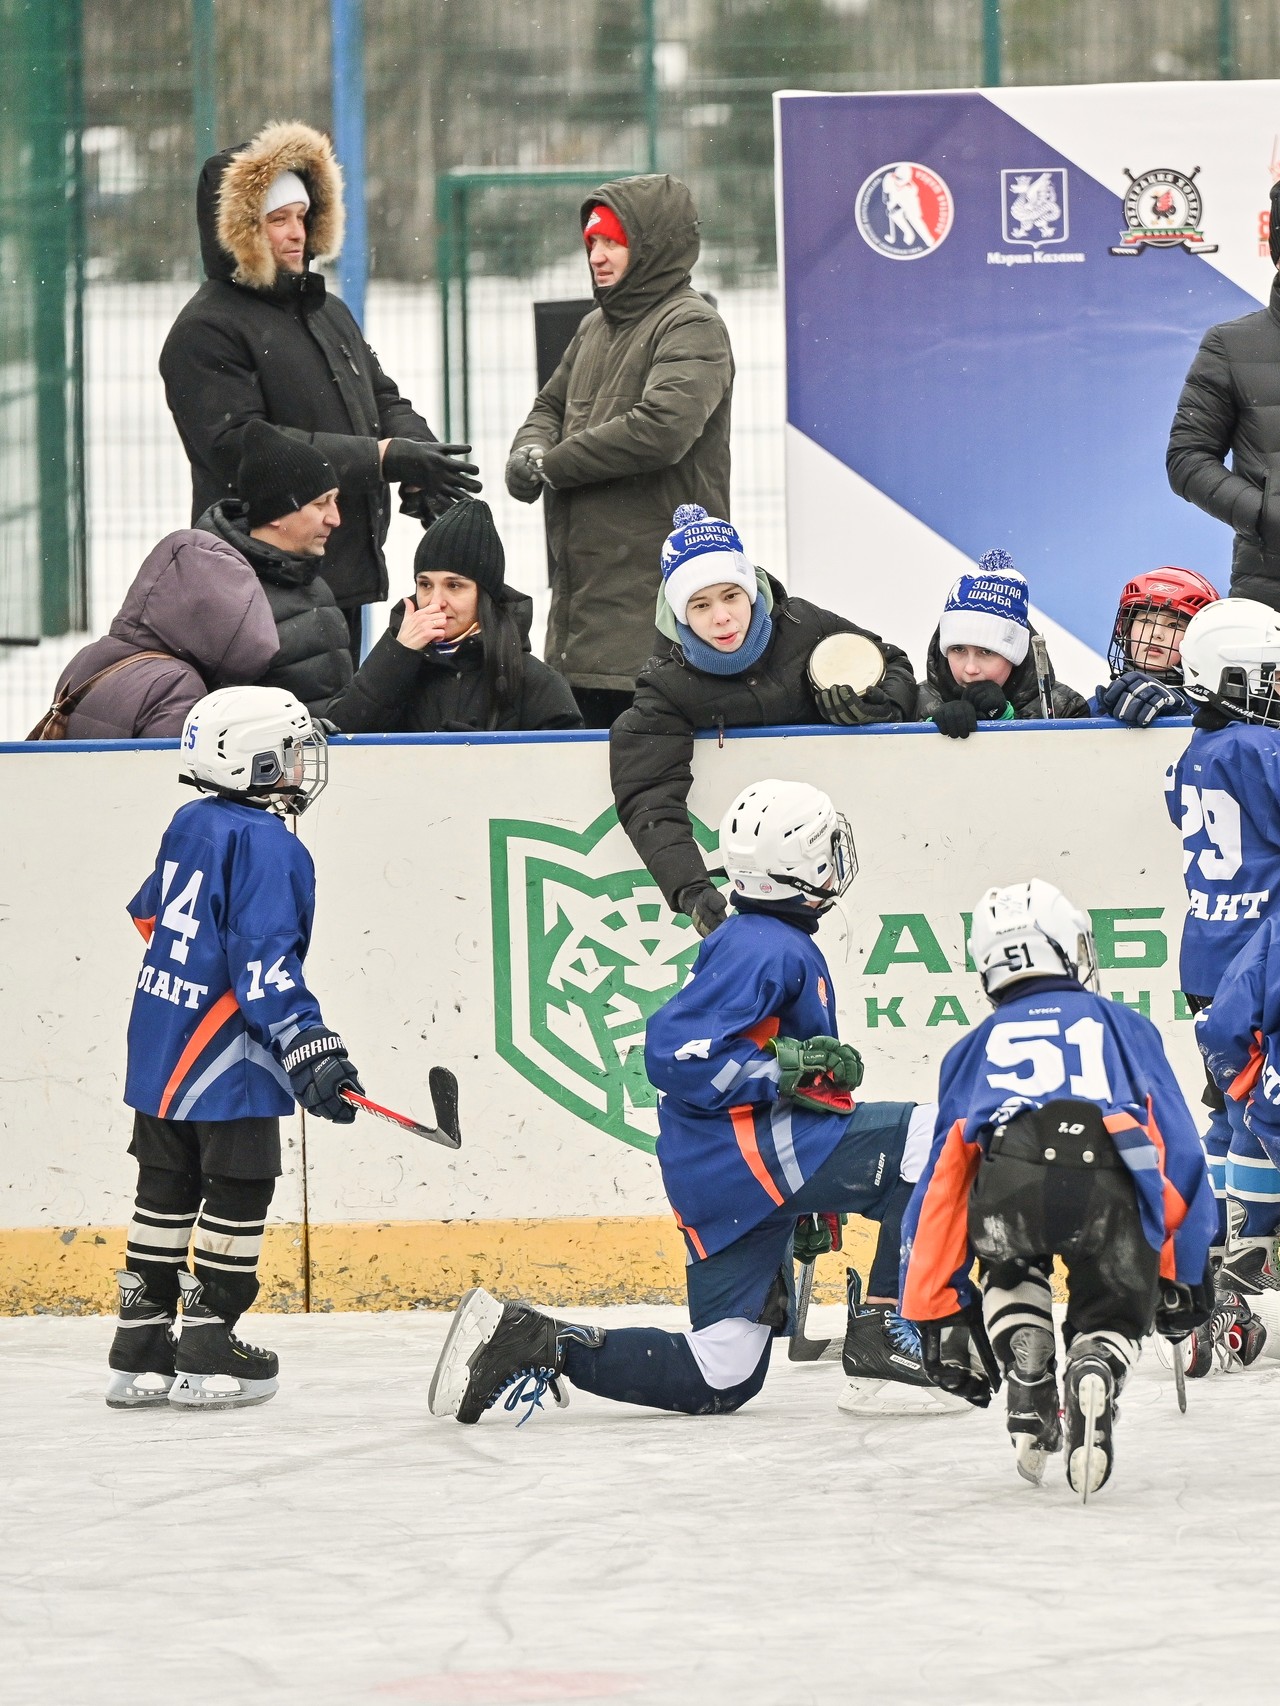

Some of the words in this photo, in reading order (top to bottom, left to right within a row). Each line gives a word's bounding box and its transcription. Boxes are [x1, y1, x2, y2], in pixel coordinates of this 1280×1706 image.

[987, 252, 1032, 267] Мэрия
[684, 525, 735, 537] ЗОЛОТАЯ
[684, 533, 730, 546] ШАЙБА
[968, 590, 1011, 608] ШАЙБА
[972, 580, 1021, 599] ЗОЛОТАЯ
[148, 860, 204, 965] 4
[138, 962, 208, 1009] ЛАНТ
[246, 956, 296, 1001] 14
[282, 1036, 347, 1073] WARRIOR
[985, 1017, 1113, 1104] 51
